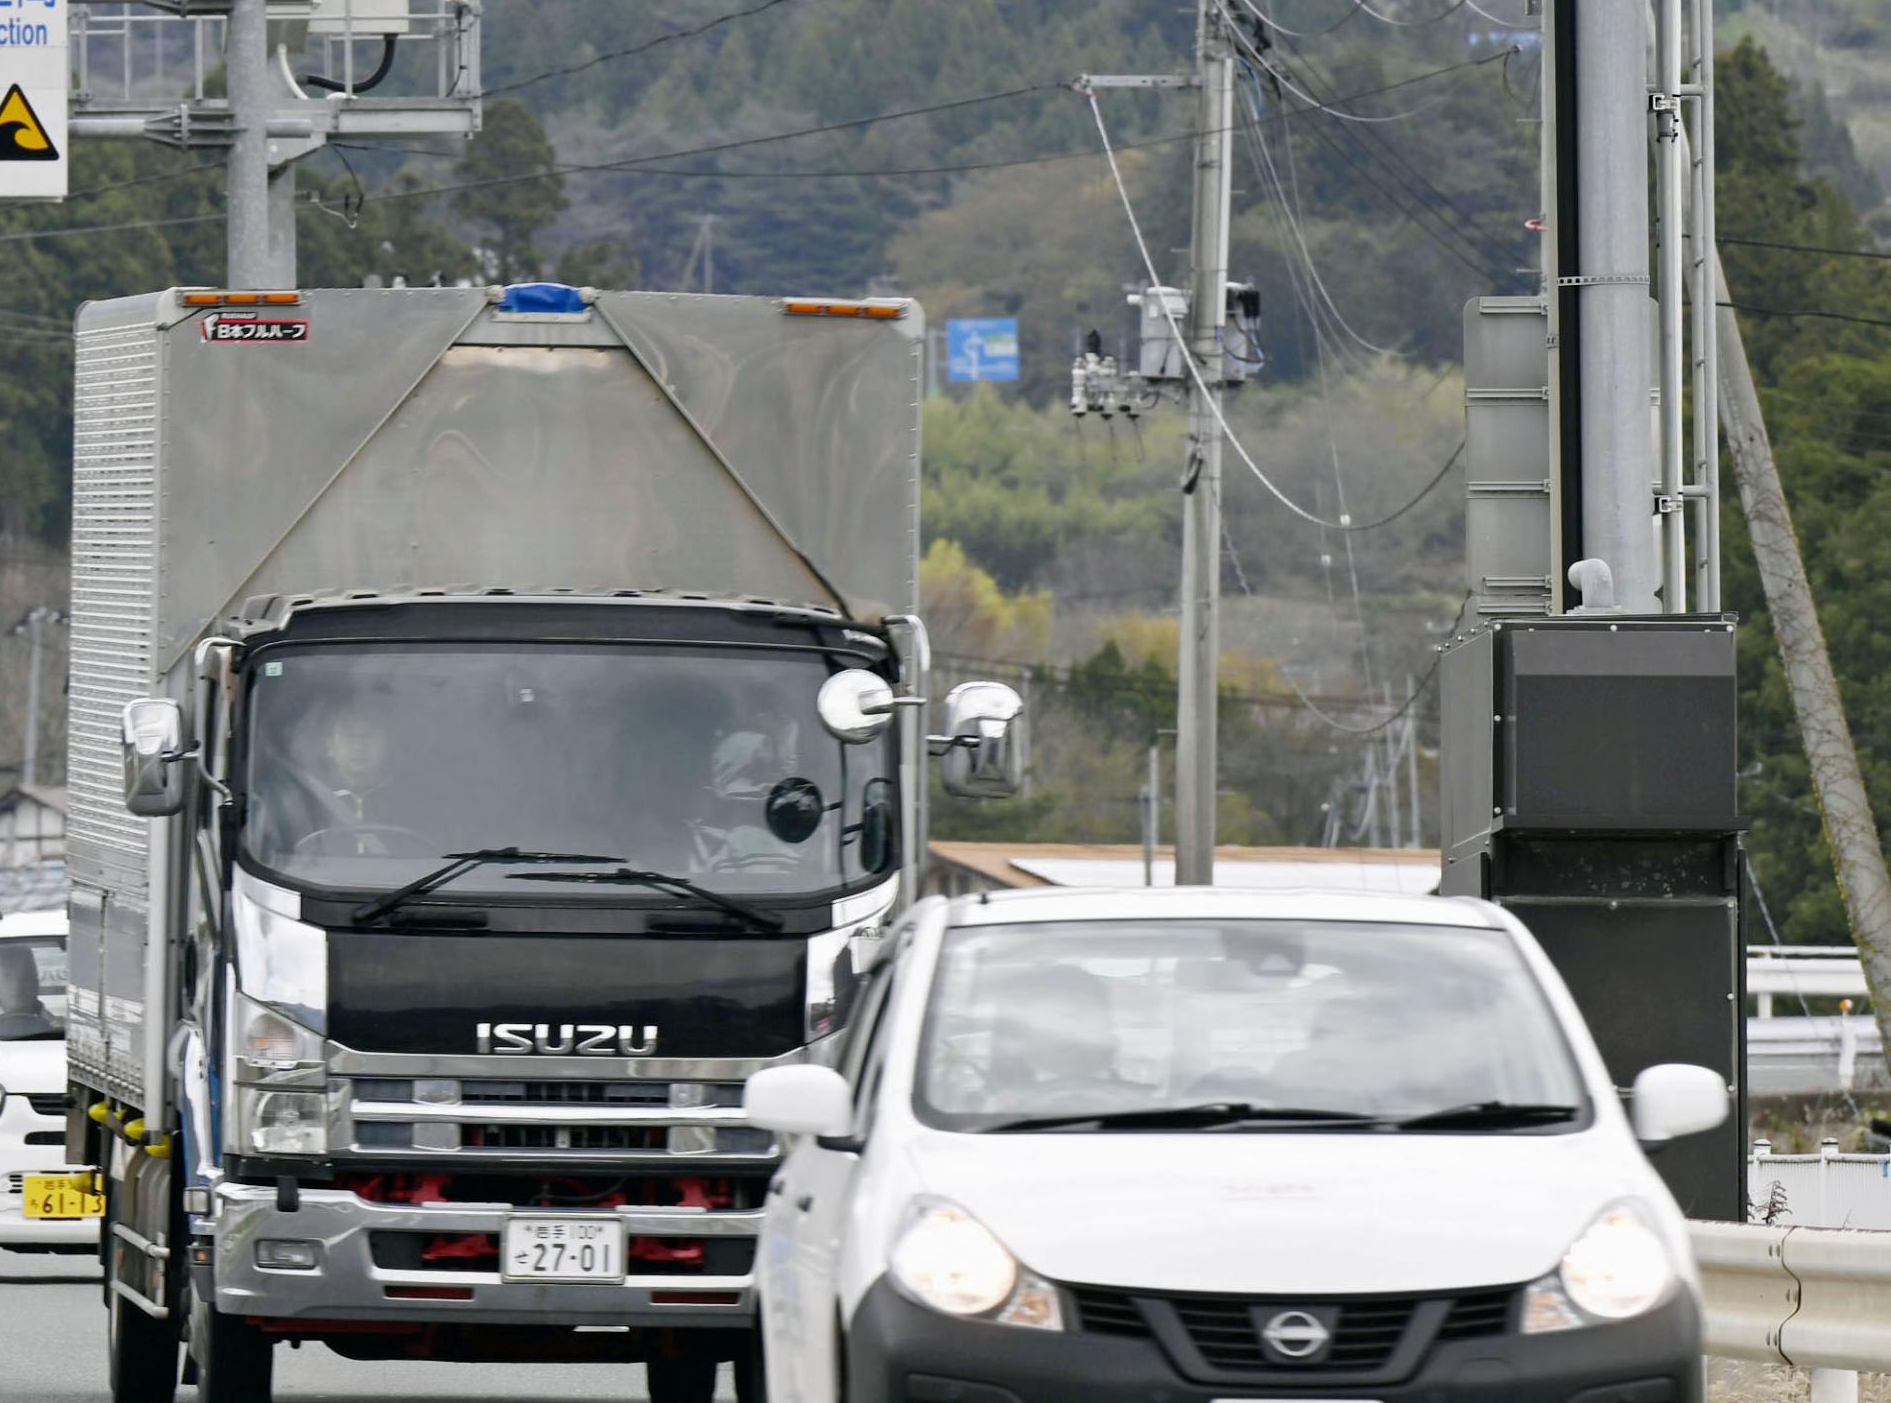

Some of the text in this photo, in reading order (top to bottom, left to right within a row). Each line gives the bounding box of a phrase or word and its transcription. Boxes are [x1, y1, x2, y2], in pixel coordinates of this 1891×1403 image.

[217, 324, 306, 339] 日本フルハーフ
[476, 1022, 659, 1056] ISUZU
[532, 1243, 611, 1273] 27-01
